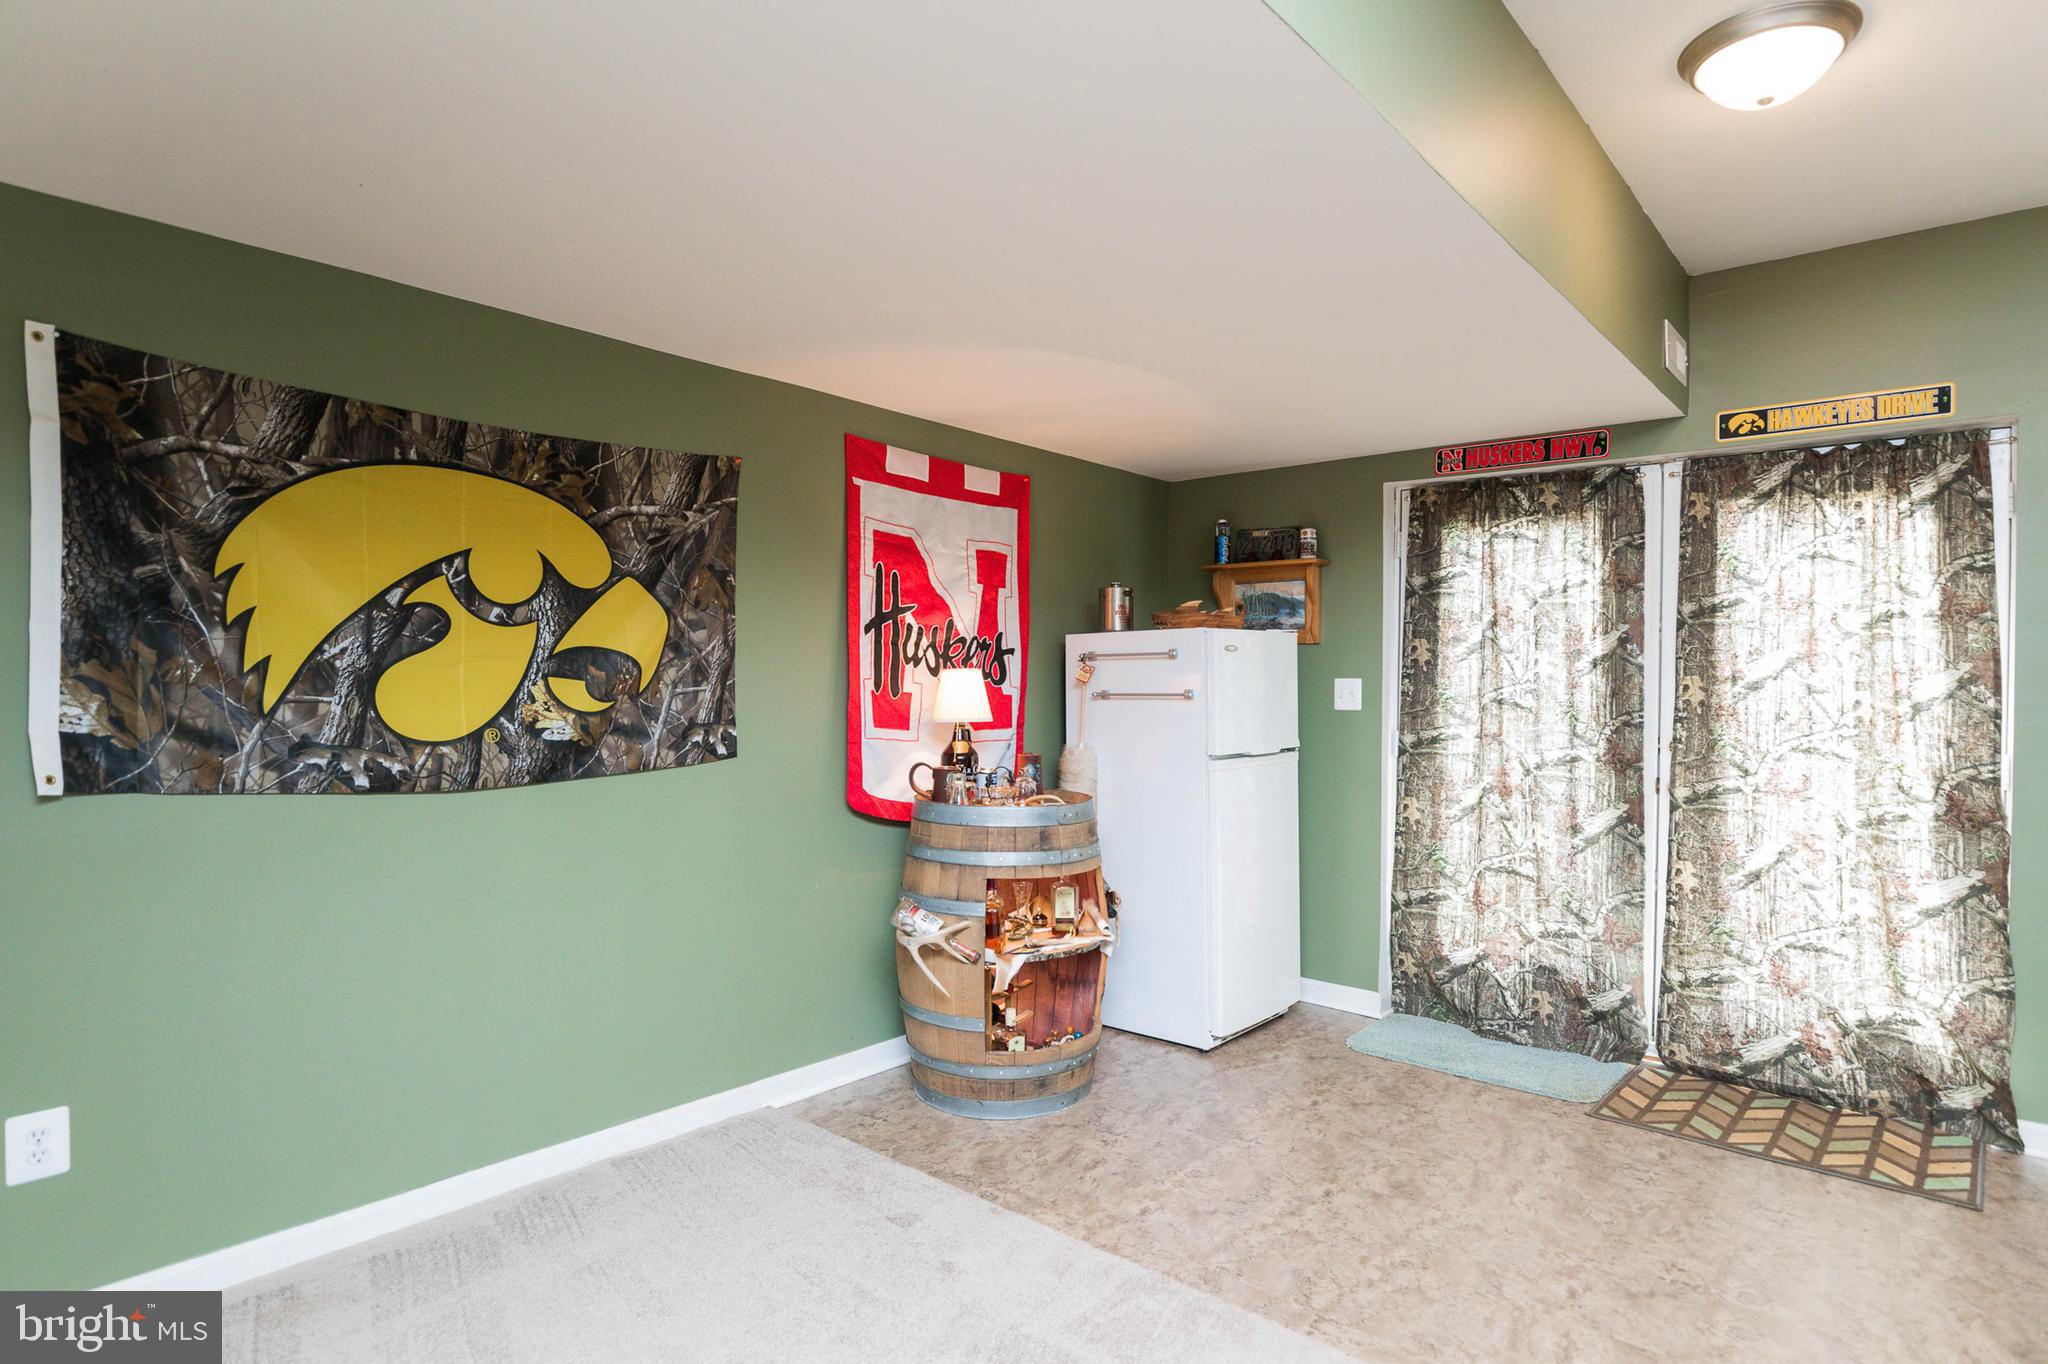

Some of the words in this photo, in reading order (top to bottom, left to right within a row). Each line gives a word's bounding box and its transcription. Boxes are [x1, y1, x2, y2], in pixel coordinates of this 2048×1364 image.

[1767, 397, 1874, 433] HAWKEYES
[1877, 388, 1939, 419] DRIVE
[1465, 439, 1545, 469] HUSKERS
[1550, 432, 1602, 460] HWY.
[863, 561, 1016, 700] Huskers
